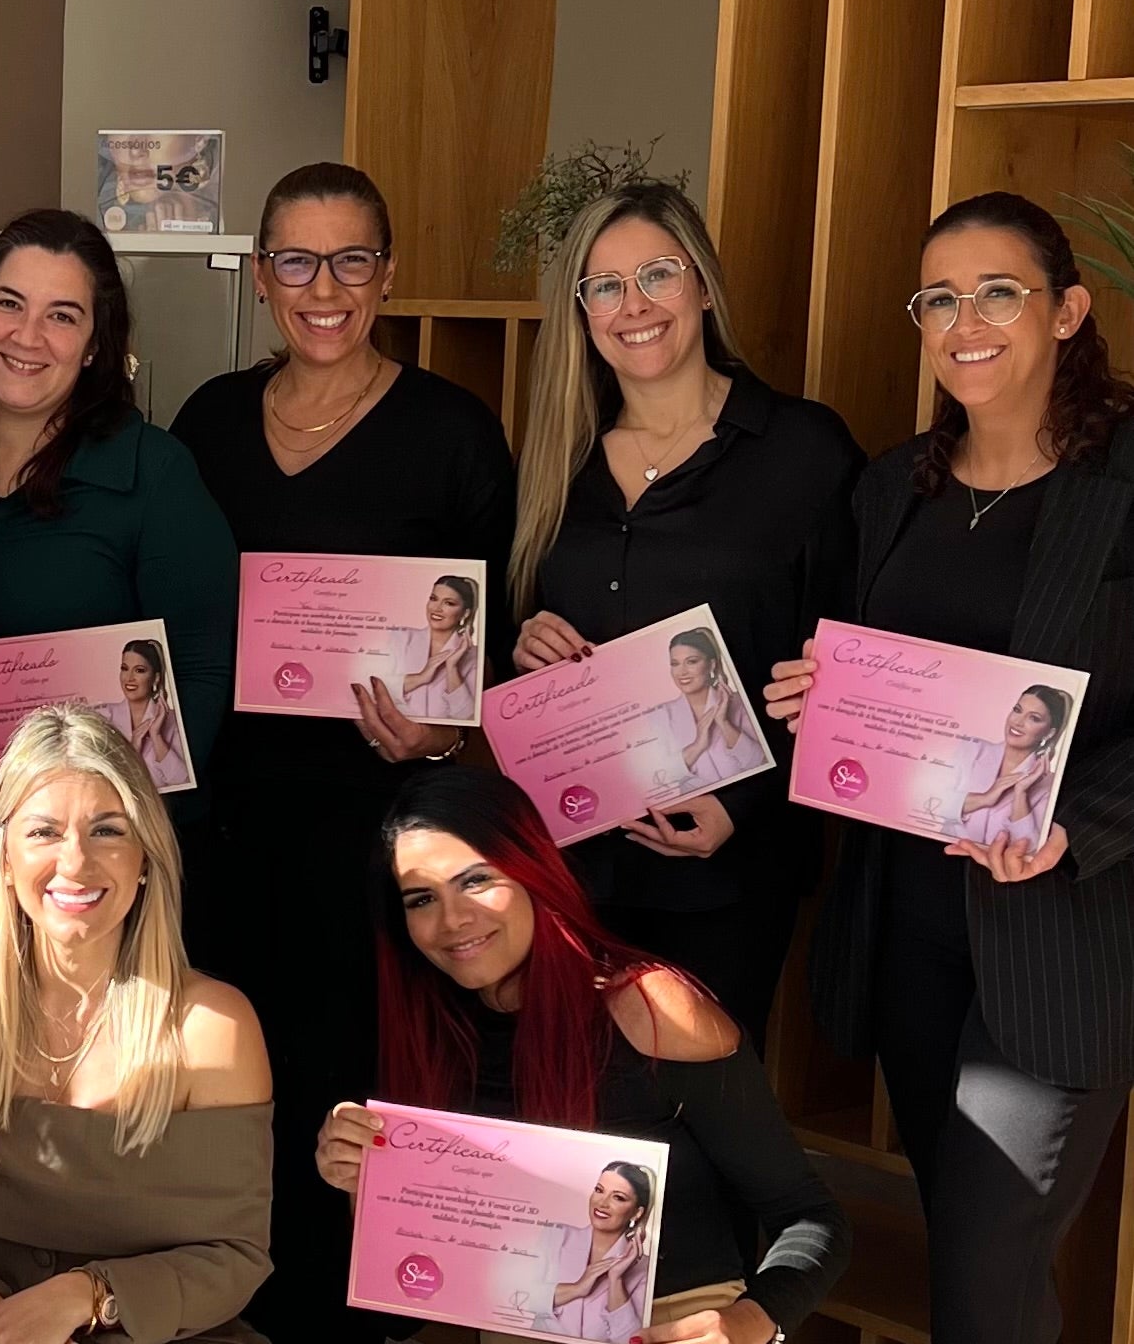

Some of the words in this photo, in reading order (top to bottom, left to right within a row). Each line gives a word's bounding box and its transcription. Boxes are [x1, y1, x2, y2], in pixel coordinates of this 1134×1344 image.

[100, 138, 162, 150] Acessórios
[156, 164, 201, 193] 5€
[261, 559, 363, 592] Certificado
[834, 638, 942, 679] Certificado
[500, 666, 599, 720] Certificado
[389, 1121, 513, 1165] Certificado
